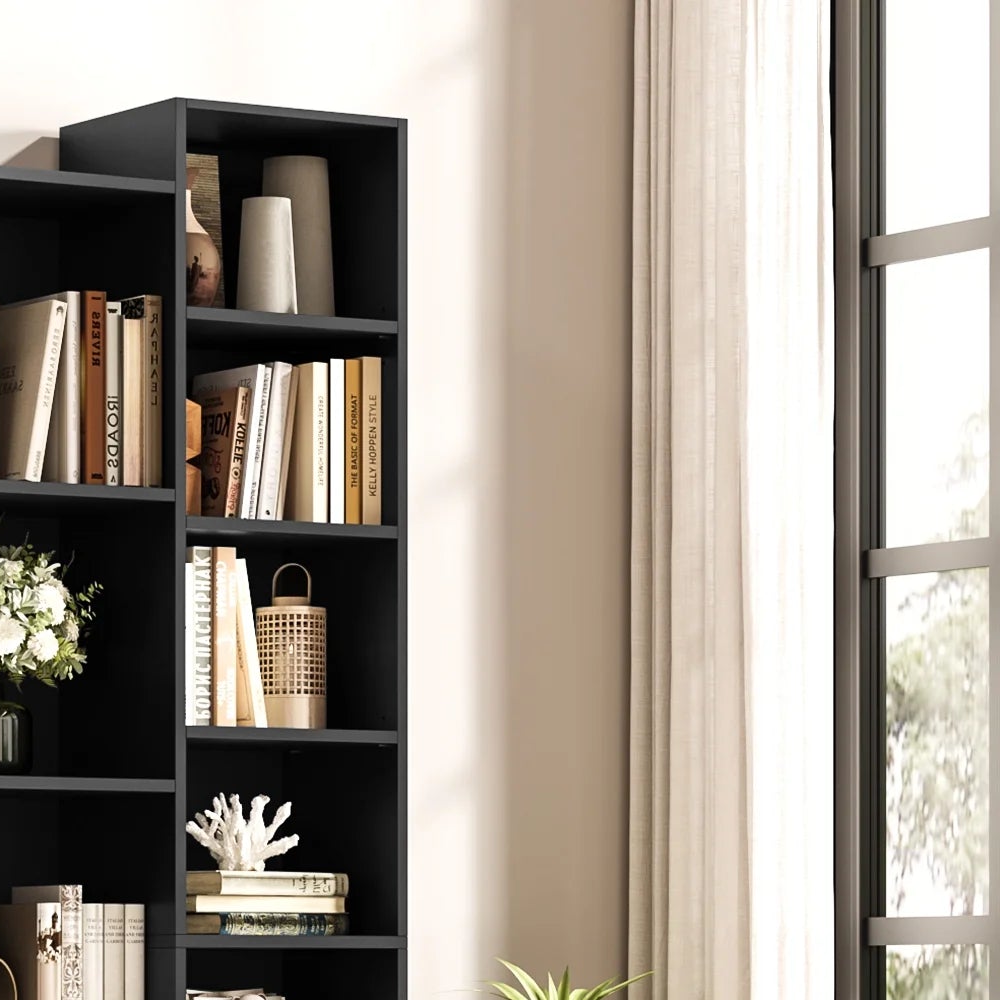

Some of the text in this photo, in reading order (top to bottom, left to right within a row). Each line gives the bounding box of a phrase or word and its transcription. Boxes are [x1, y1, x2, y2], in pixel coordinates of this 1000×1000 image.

[351, 395, 360, 488] THE BASIC OF FORMAT
[369, 395, 377, 424] STYLE
[195, 556, 211, 719] БОРИС ПАСТЕРНАК
